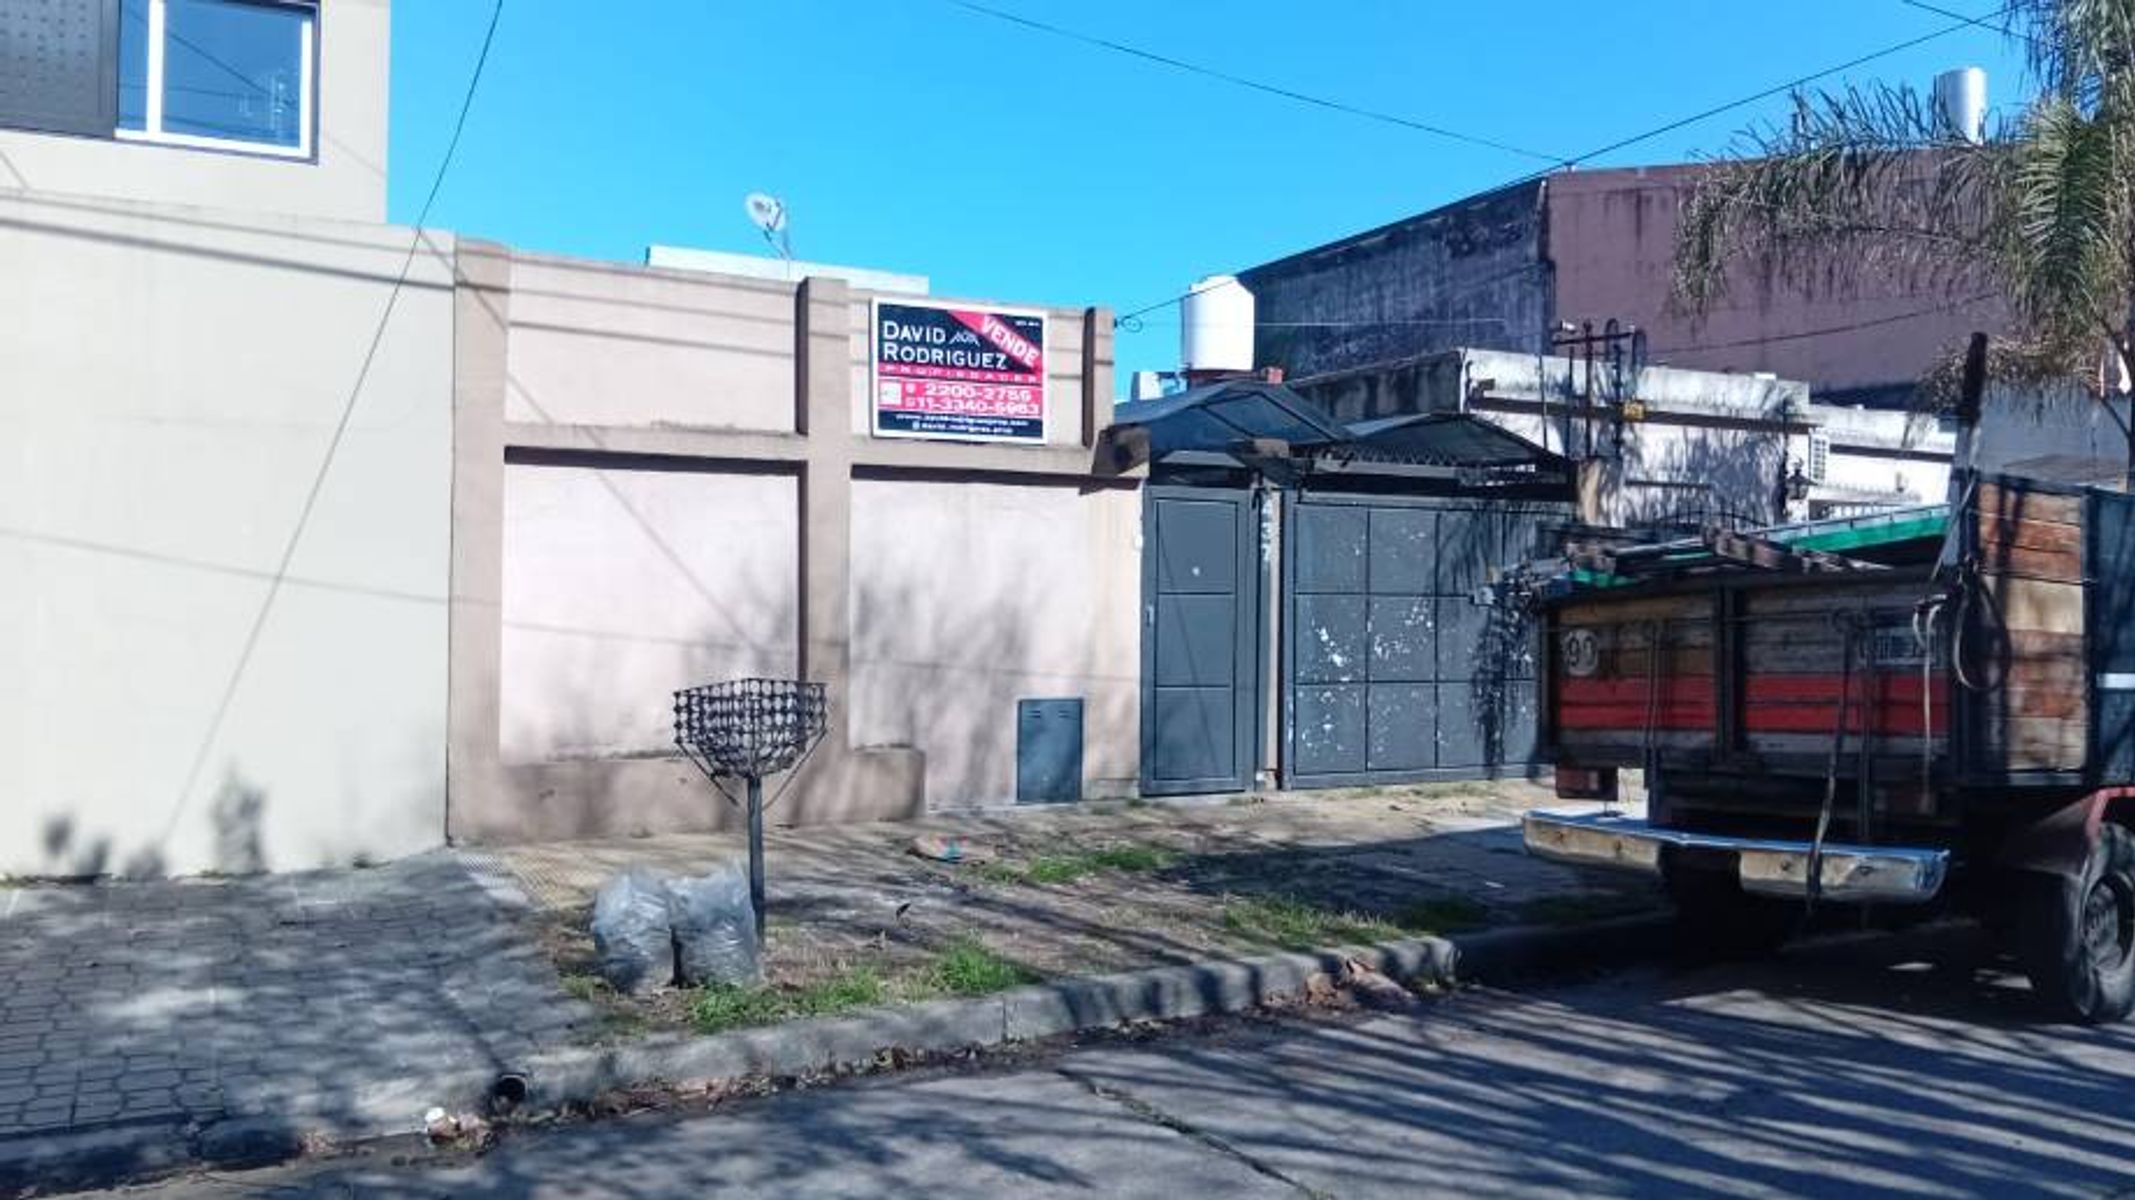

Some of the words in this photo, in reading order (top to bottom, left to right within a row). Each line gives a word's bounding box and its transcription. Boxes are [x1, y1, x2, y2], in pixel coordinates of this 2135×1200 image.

[883, 321, 946, 343] DAVID
[981, 315, 1040, 366] VENDE
[883, 343, 1008, 370] RODRIGUEZ
